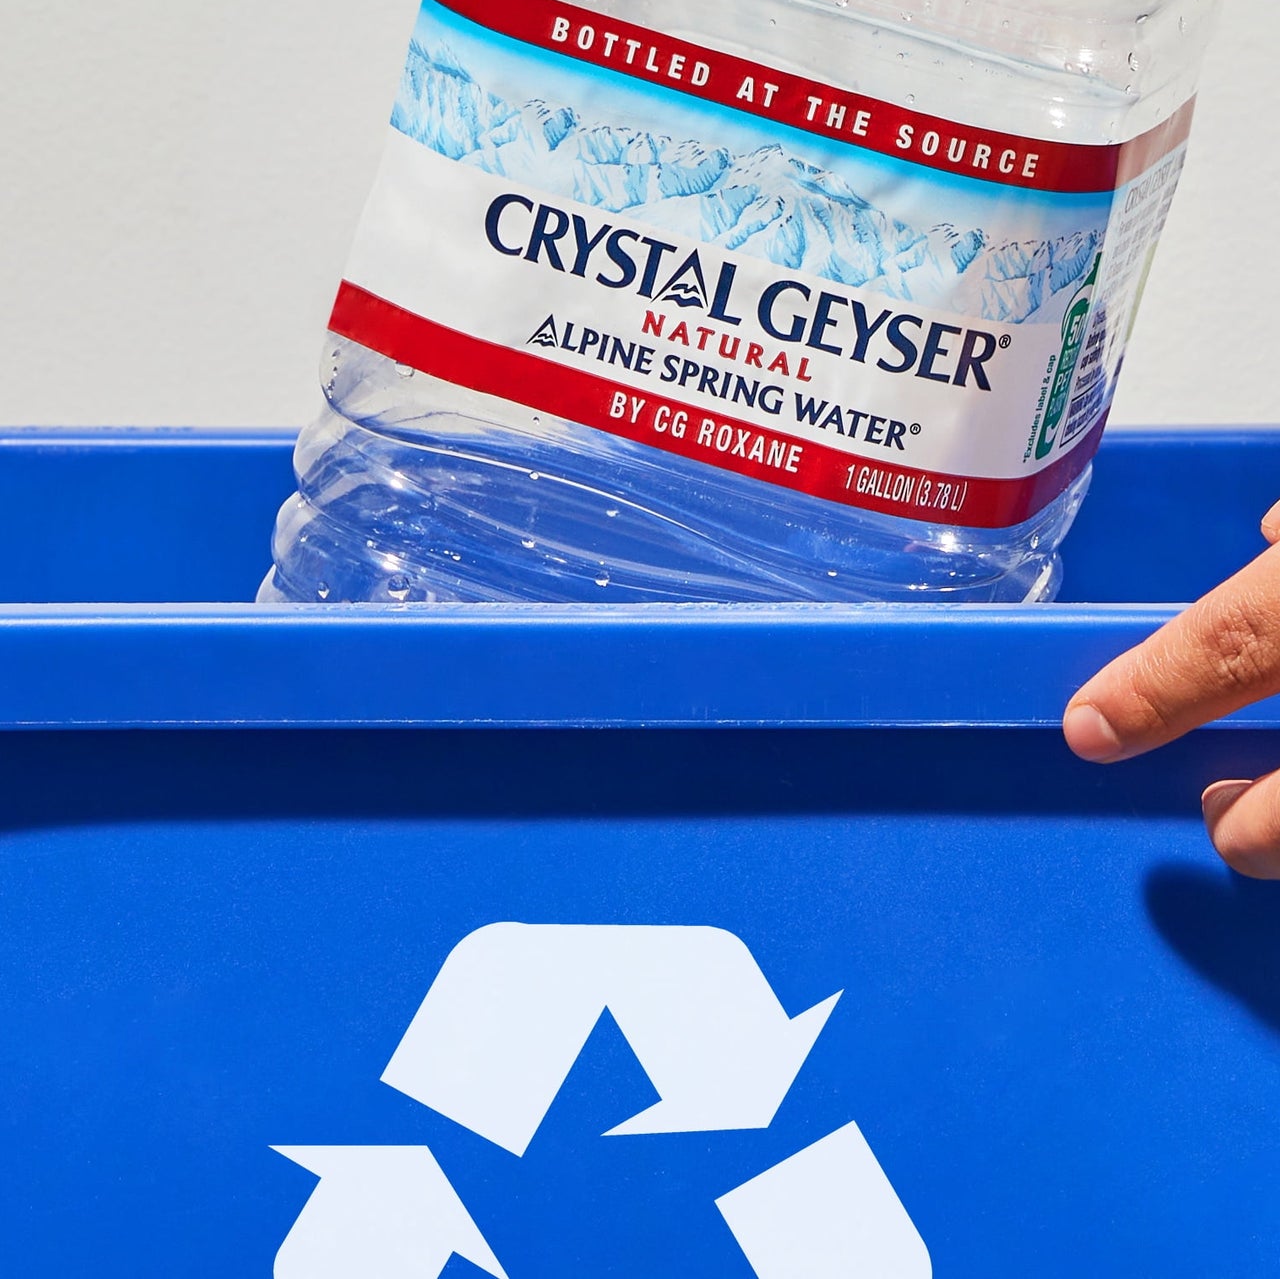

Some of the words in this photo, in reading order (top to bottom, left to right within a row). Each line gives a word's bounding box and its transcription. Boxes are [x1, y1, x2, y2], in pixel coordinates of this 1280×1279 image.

[551, 16, 711, 87] BOTTLED
[736, 76, 780, 108] AT
[804, 95, 871, 137] THE
[895, 123, 1040, 179] SOURCE
[484, 193, 743, 326] CRYSTAL
[526, 313, 656, 375] ALPINE
[659, 354, 785, 415] SPRING
[641, 310, 813, 382] NATURAL
[1035, 386, 1048, 411] label
[1046, 354, 1057, 374] cap
[609, 391, 647, 424] BY
[653, 405, 689, 439] CG
[696, 418, 804, 473] ROXANE
[845, 464, 856, 490] 1
[856, 466, 916, 504] GALLON
